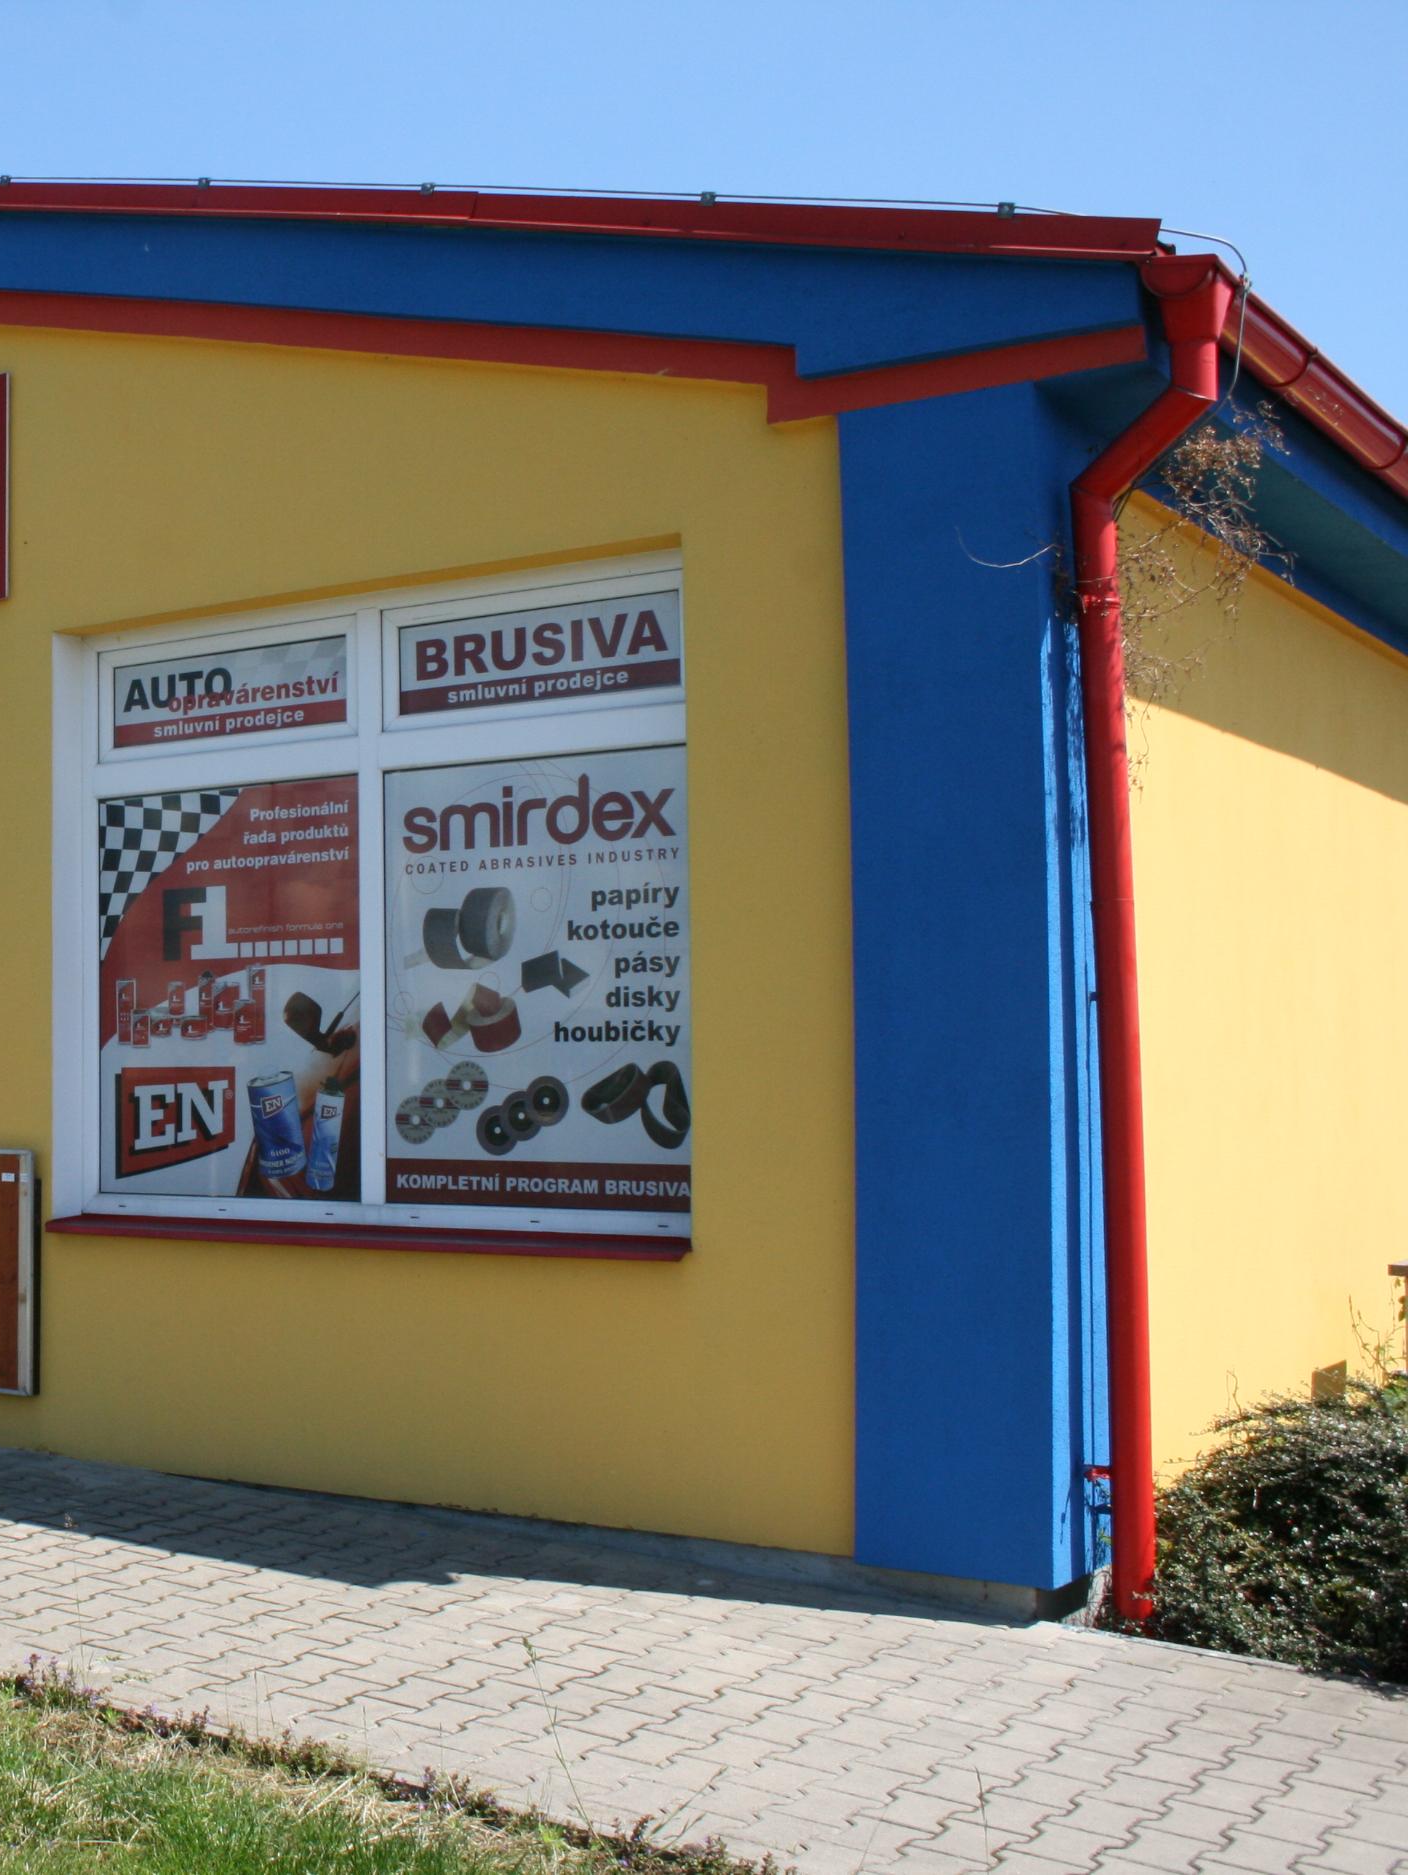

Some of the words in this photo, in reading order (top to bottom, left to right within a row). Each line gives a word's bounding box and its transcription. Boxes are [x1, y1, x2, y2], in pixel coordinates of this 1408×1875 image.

[415, 609, 669, 682] BRUSIVA
[123, 667, 232, 713] AUTO
[168, 671, 339, 715] opravárenství
[447, 678, 527, 704] smluvní
[534, 671, 630, 698] prodejce
[154, 716, 220, 738] smluvní
[226, 709, 305, 733] prodejce
[249, 800, 349, 822] Profesionální
[402, 773, 676, 854] smirdex
[243, 831, 276, 845] řada
[281, 825, 349, 849] produktů
[186, 859, 210, 874] pro
[213, 847, 349, 872] autoopravárenství
[405, 860, 469, 876] COATED
[478, 853, 577, 871] ABRASIVES
[587, 847, 680, 865] INDUSTRY
[591, 882, 680, 911] papíry
[567, 916, 680, 941] kotouče
[614, 951, 681, 978] pásy
[606, 986, 681, 1012] disky
[555, 1020, 681, 1046] houbičky
[264, 1096, 281, 1113] EN
[396, 1173, 500, 1192] KOMPLETNÍ
[506, 1176, 598, 1195] PROGRAM
[605, 1179, 691, 1198] BRUSIVA
